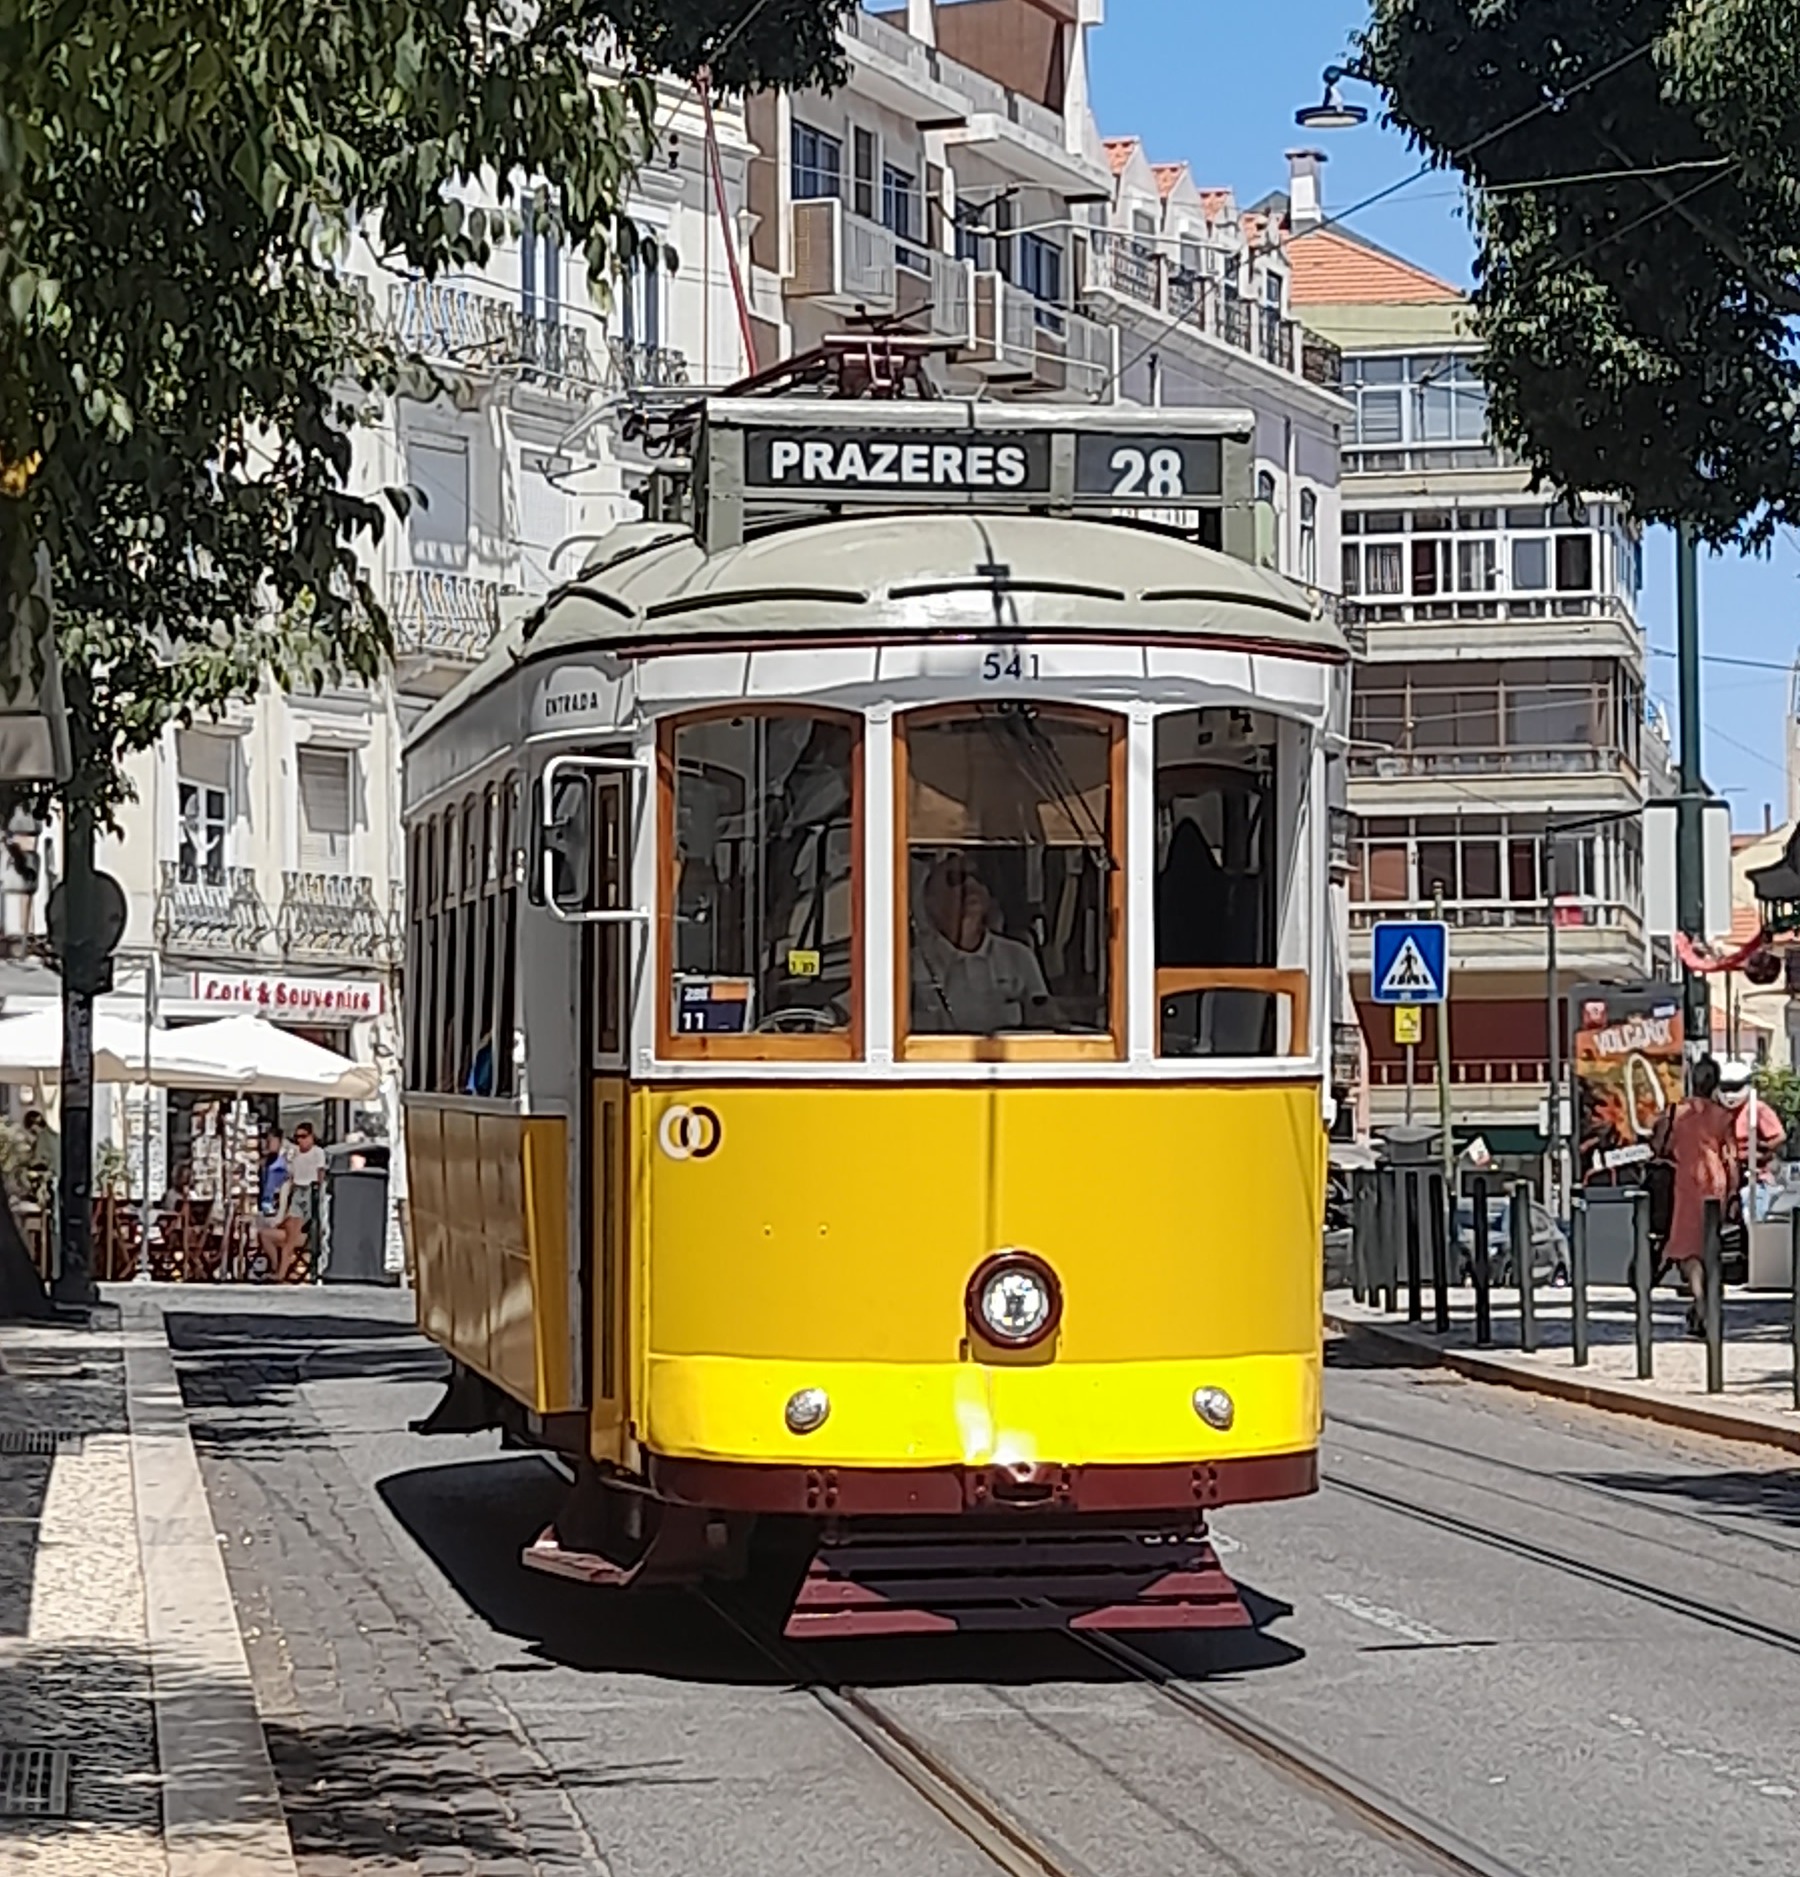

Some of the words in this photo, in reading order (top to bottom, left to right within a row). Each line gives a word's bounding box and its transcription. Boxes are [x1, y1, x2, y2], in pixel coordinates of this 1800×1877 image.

[771, 441, 1026, 486] PRAZERES
[1111, 449, 1183, 498] 28
[983, 652, 1039, 681] 541
[545, 691, 598, 717] ENTRADA
[205, 979, 252, 1001] Cork
[257, 981, 271, 1005] &
[276, 982, 370, 1011] Souvenirs
[682, 1012, 704, 1030] 11
